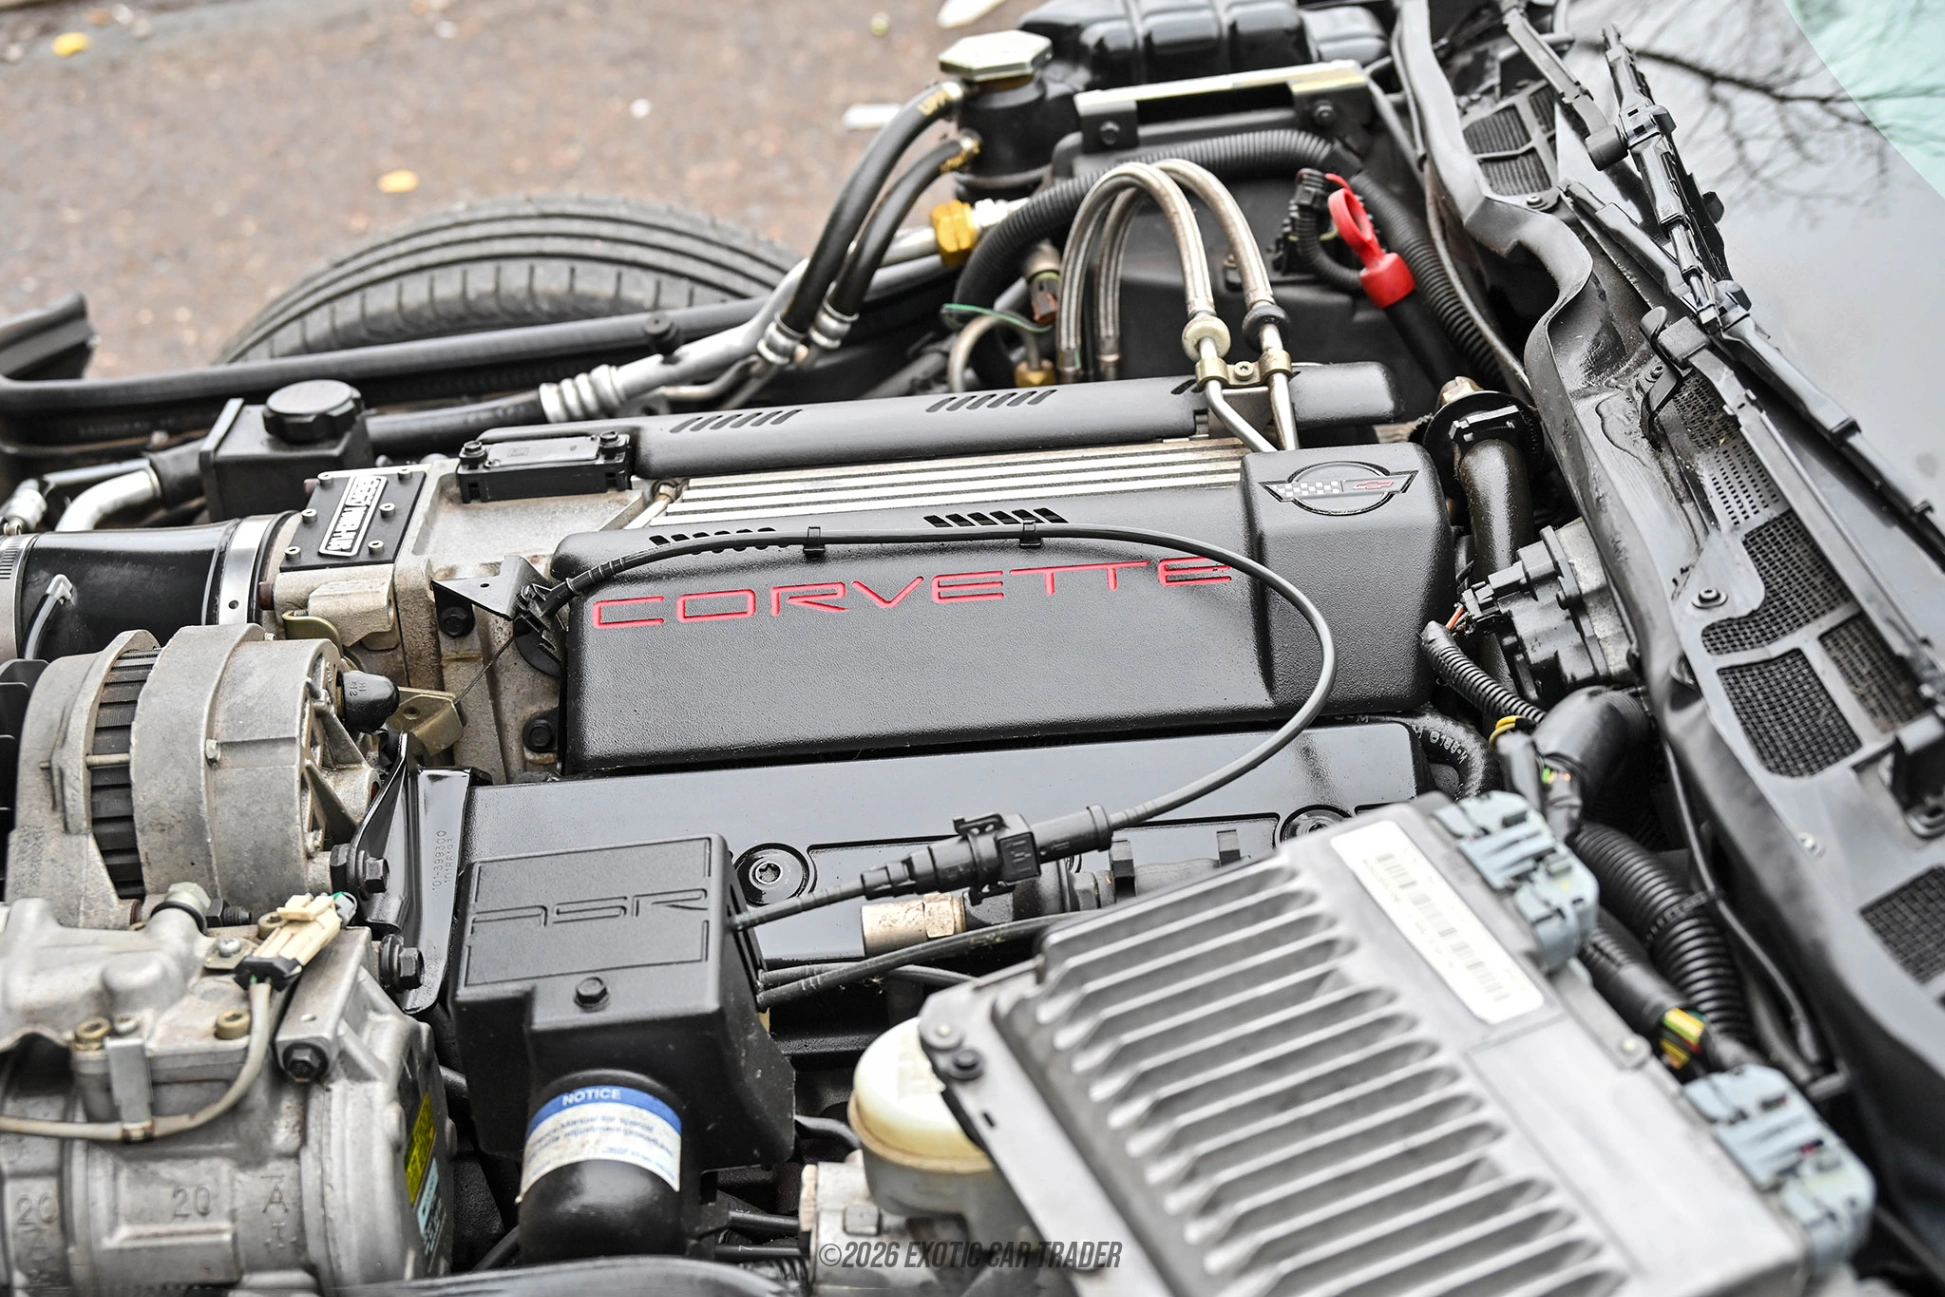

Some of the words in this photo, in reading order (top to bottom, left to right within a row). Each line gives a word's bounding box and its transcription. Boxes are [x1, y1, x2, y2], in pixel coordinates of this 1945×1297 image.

[591, 555, 1231, 629] CORVETTE
[470, 887, 708, 935] ASR
[562, 1088, 622, 1107] NOTICE
[16, 1193, 59, 1226] 20
[171, 1185, 212, 1219] 20
